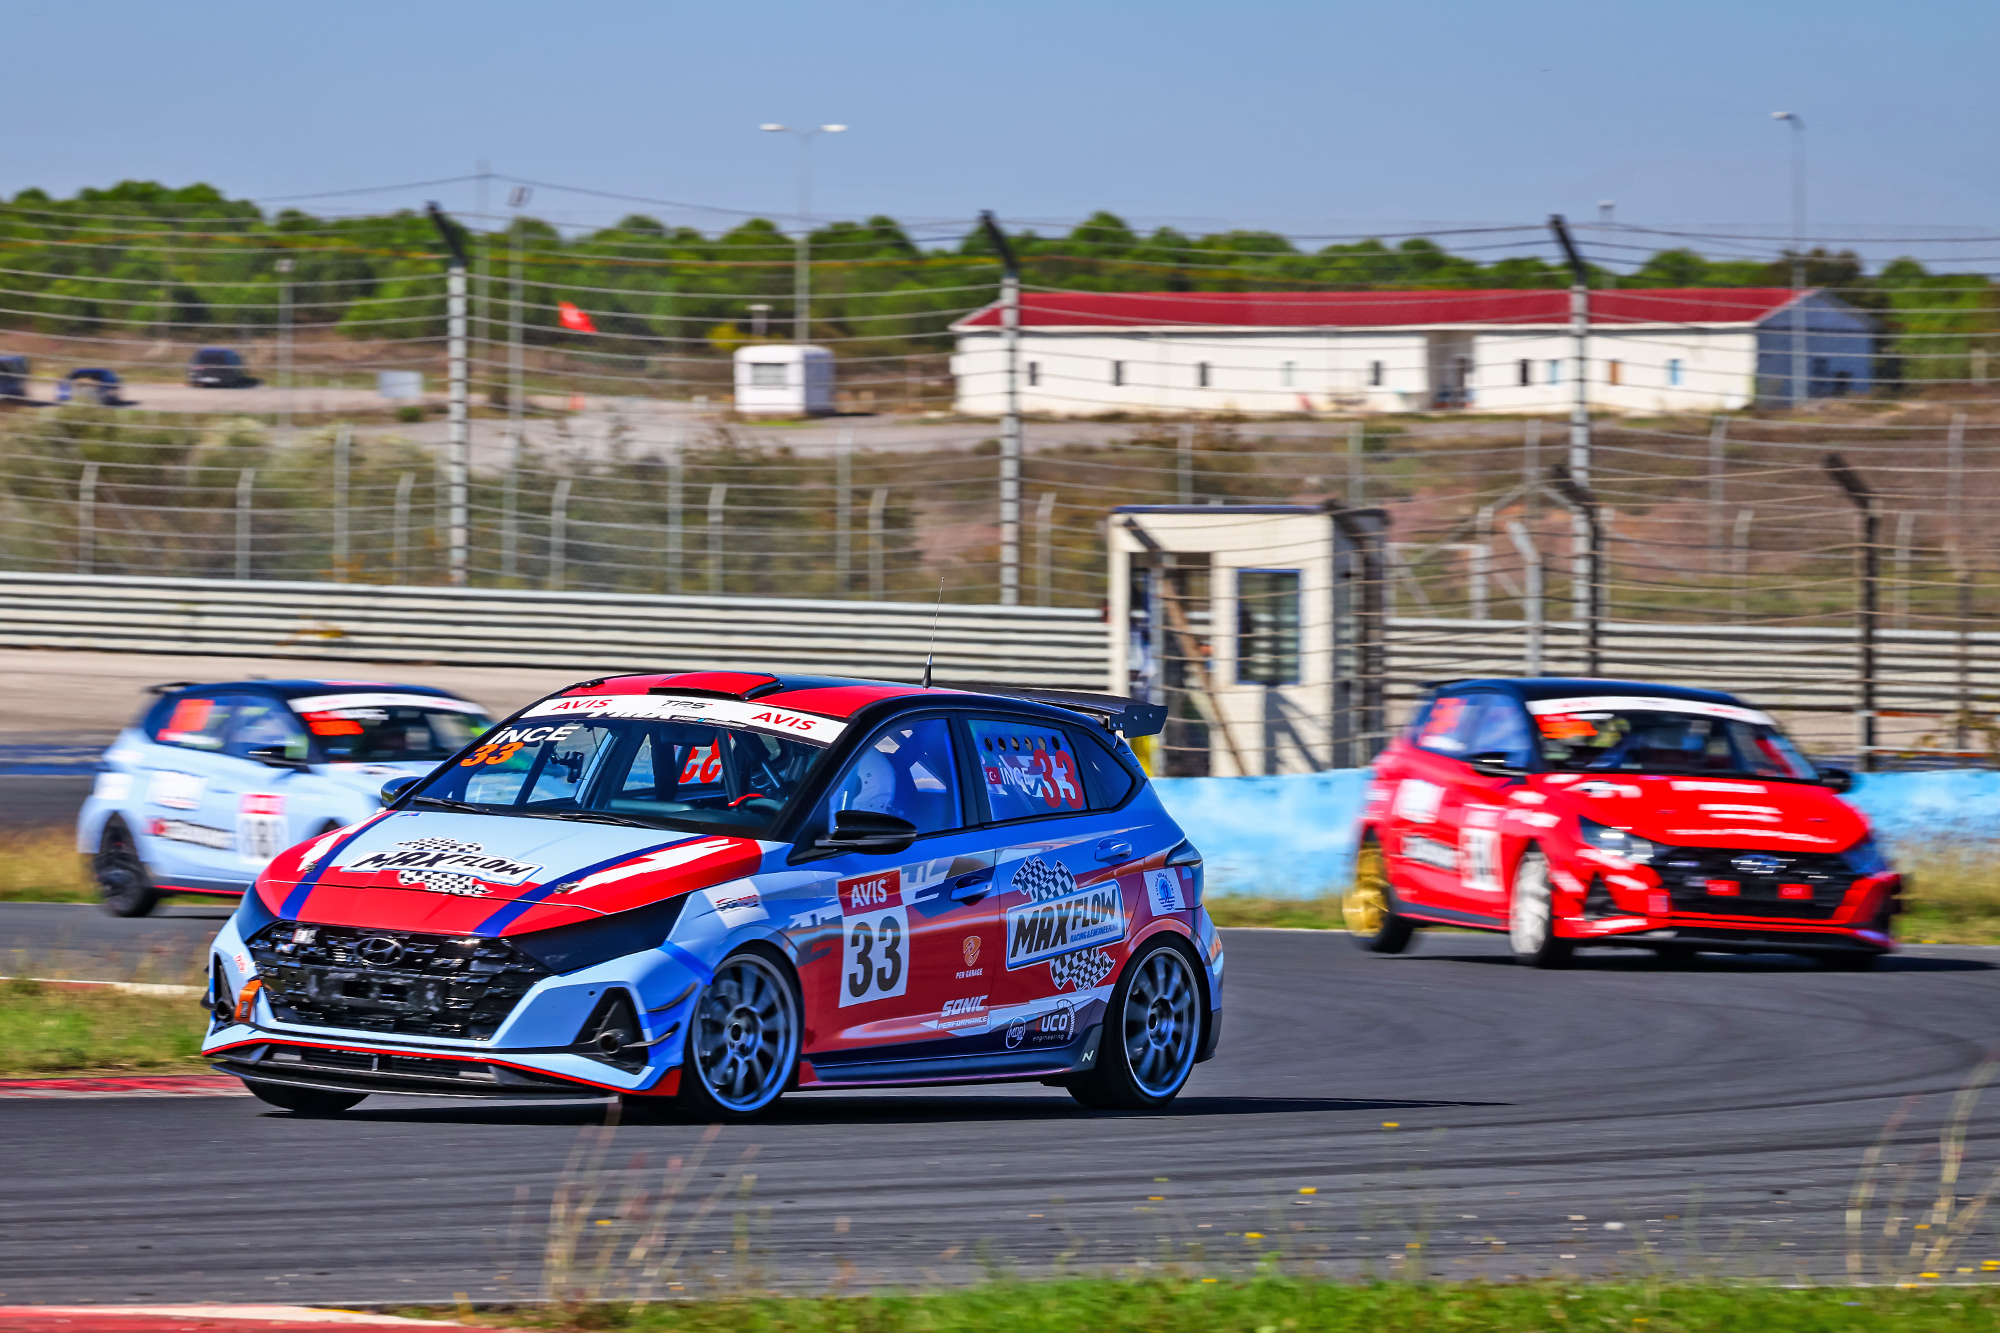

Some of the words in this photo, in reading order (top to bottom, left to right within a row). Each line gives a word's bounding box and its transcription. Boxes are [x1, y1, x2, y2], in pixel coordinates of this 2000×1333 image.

[551, 699, 613, 711] AVIS
[751, 712, 817, 730] AVIS
[460, 741, 525, 767] 33
[1033, 749, 1083, 809] 33
[351, 852, 535, 876] MAXFLOW
[851, 879, 887, 908] AVIS
[1010, 888, 1116, 958] MAXFLOW
[848, 915, 902, 997] 33
[941, 995, 988, 1017] SONIC
[938, 1015, 988, 1030] PERFORMANCE
